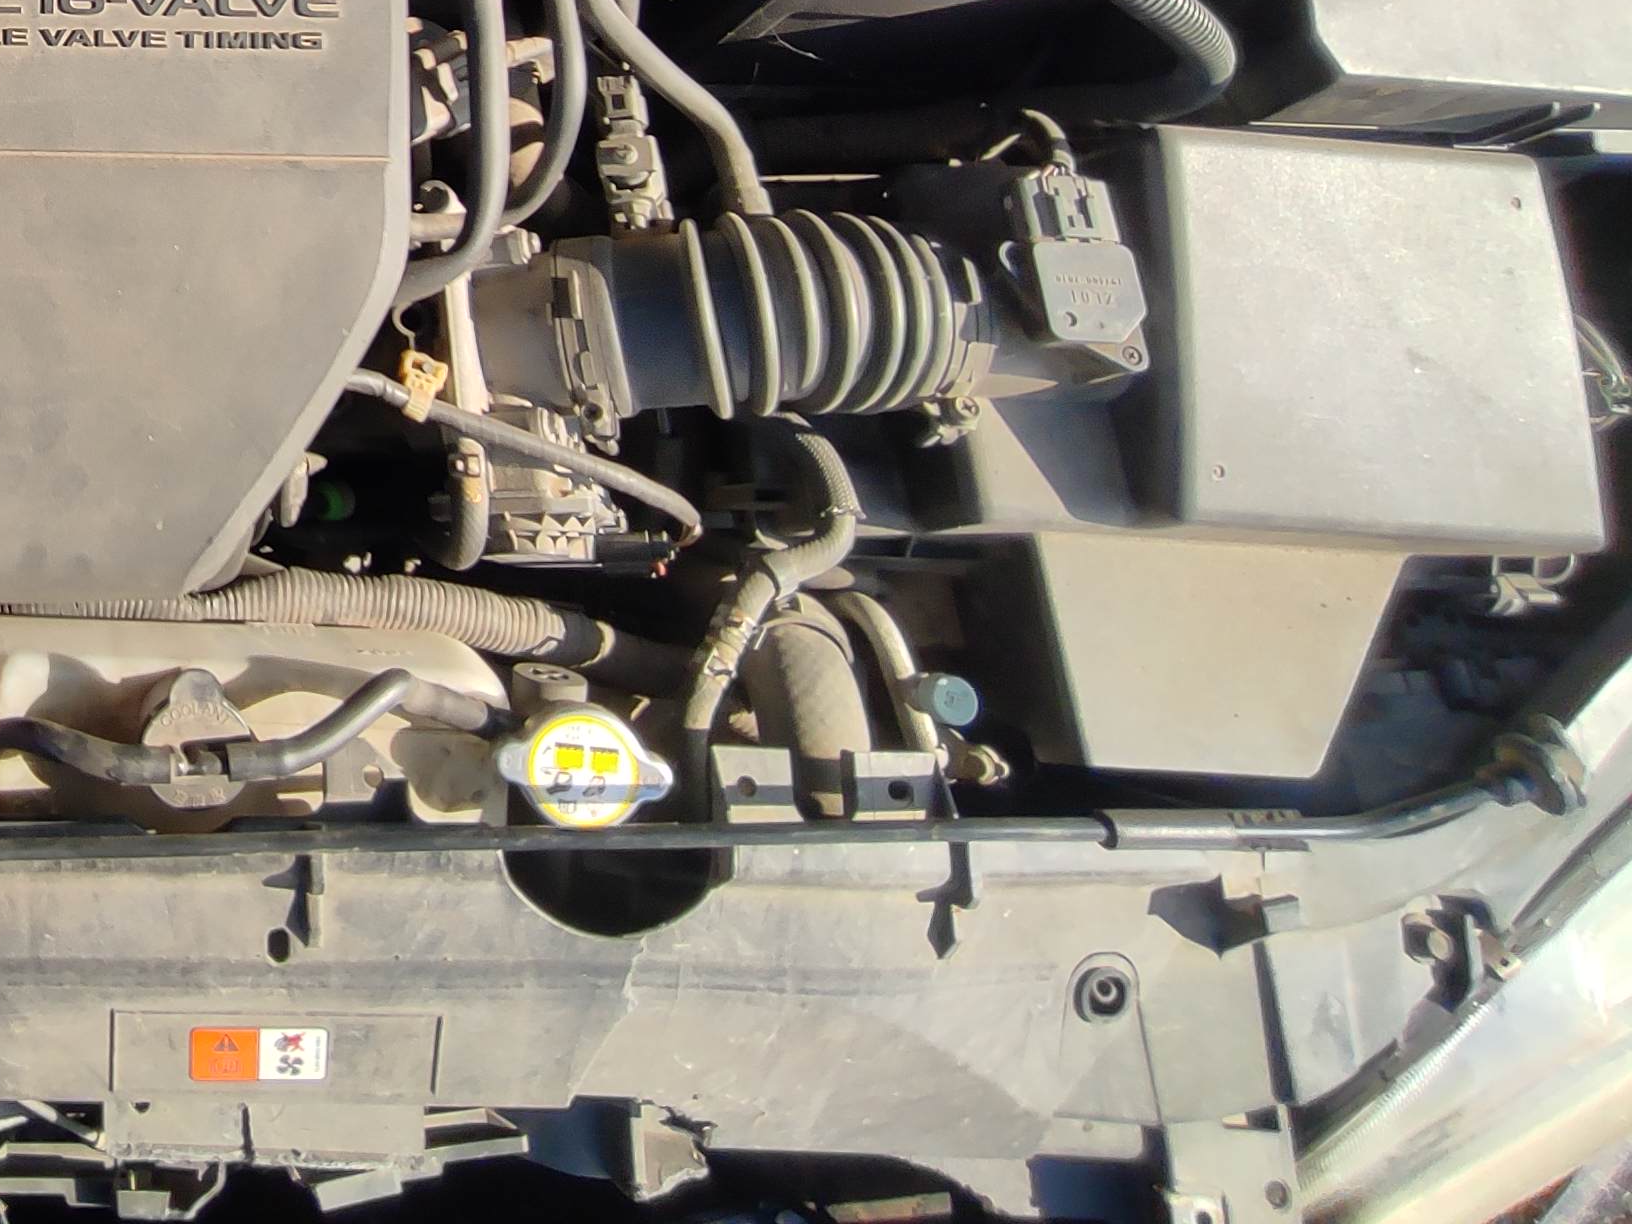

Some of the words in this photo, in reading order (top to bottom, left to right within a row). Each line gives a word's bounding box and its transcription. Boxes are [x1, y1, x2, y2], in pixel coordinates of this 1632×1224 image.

[38, 26, 168, 50] VALVE
[174, 30, 324, 51] TIMING
[160, 699, 229, 727] COOLANT
